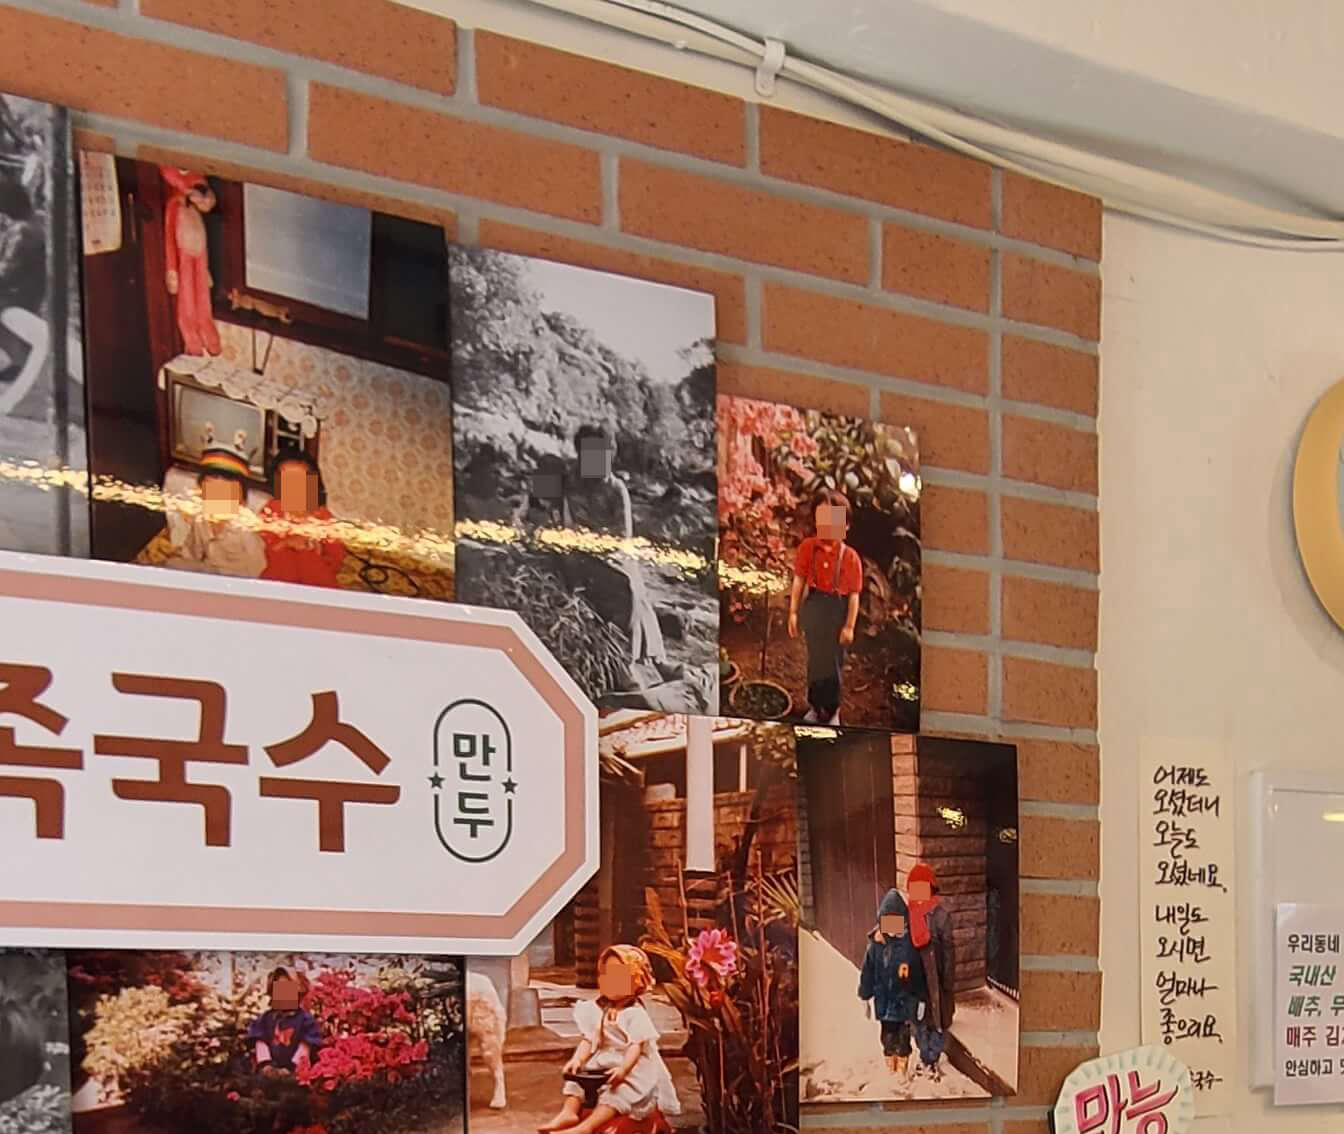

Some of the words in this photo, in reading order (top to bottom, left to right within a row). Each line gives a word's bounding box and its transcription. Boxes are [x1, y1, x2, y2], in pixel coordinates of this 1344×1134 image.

[449, 731, 498, 841] 만두
[1153, 764, 1212, 789] 어제도
[1152, 788, 1221, 817] 오셨더니
[1153, 820, 1201, 860] 오늘도
[1155, 902, 1210, 936] 내일도
[1156, 936, 1212, 964] 오시면
[1287, 933, 1341, 954] 우리동네
[1156, 970, 1220, 1003] 얼마나
[1288, 964, 1337, 988] 국내산
[1286, 1025, 1318, 1048] 매주
[1285, 1058, 1334, 1078] 안심하고
